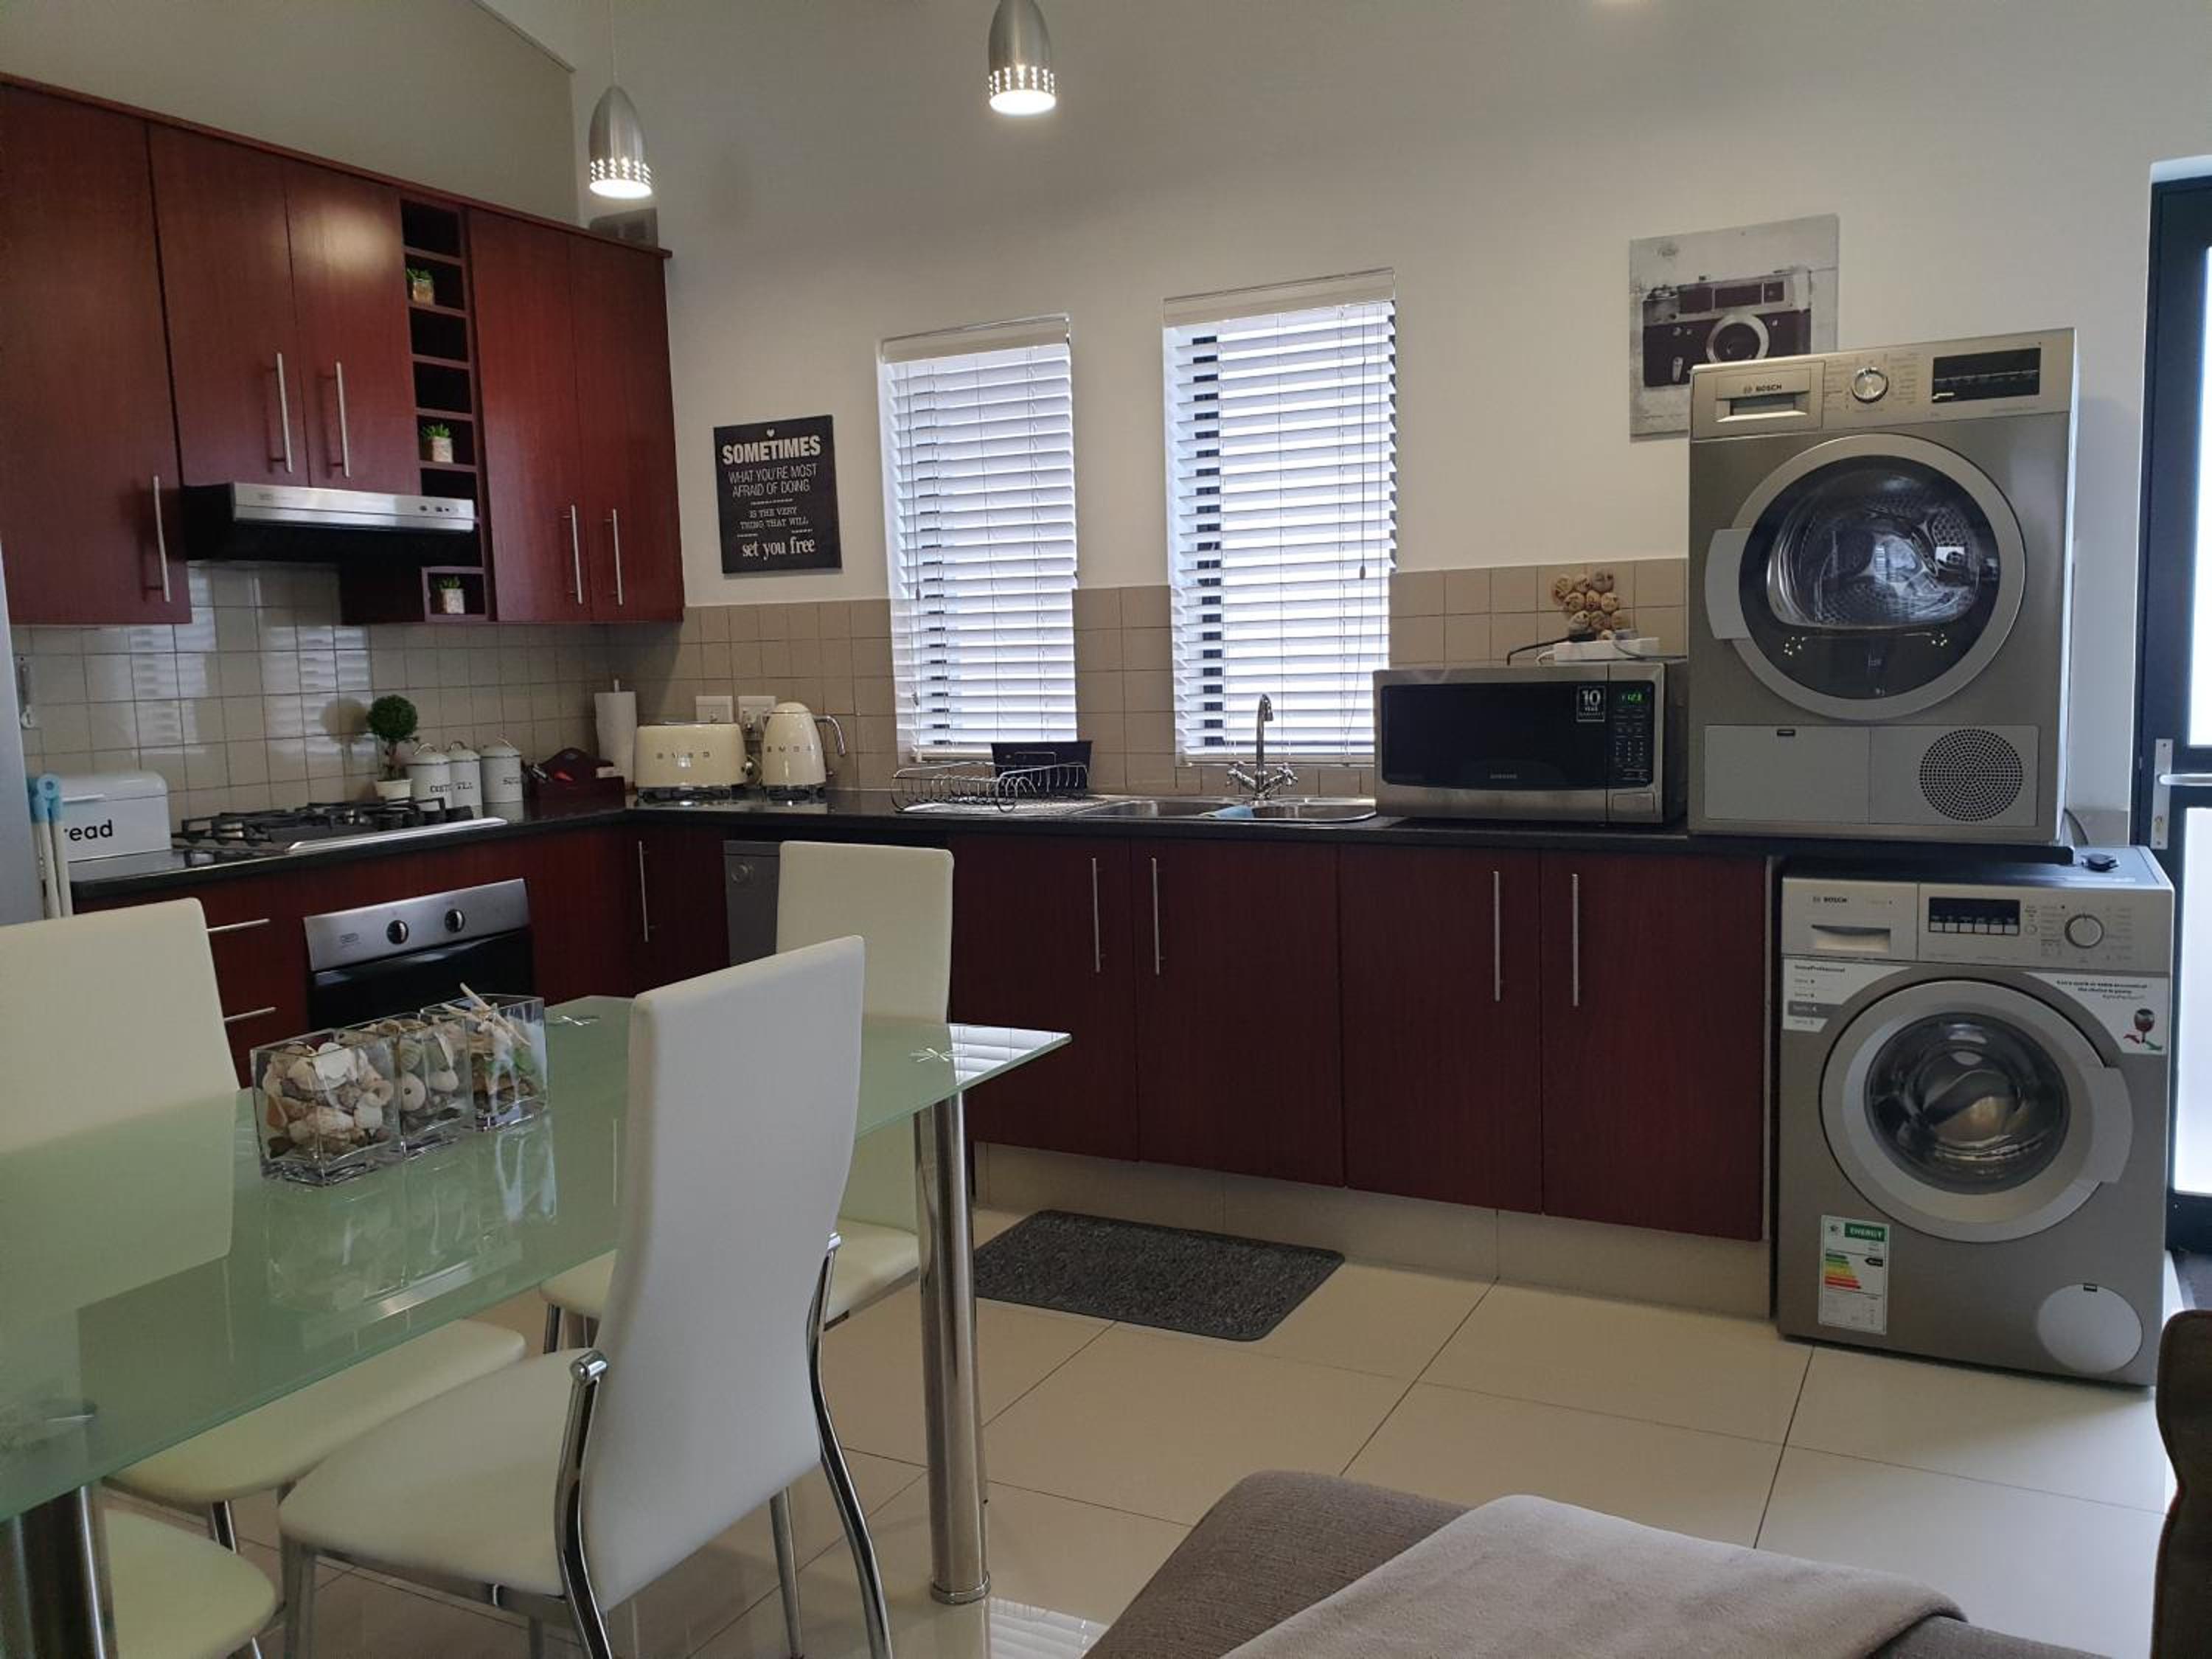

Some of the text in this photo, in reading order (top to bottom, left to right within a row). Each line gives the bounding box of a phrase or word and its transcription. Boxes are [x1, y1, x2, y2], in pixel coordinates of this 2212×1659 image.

[1756, 383, 1782, 392] BOSCH
[722, 435, 821, 465] SOMETIMES
[728, 463, 818, 484] WHAT YOU'RE MOST
[732, 479, 810, 498] AFRAID OF DOING
[749, 507, 797, 518] IS THE VERY
[740, 516, 809, 529] THING THAT WILL
[742, 536, 815, 560] set you free
[1582, 689, 1601, 706] 10
[63, 819, 113, 841] ead
